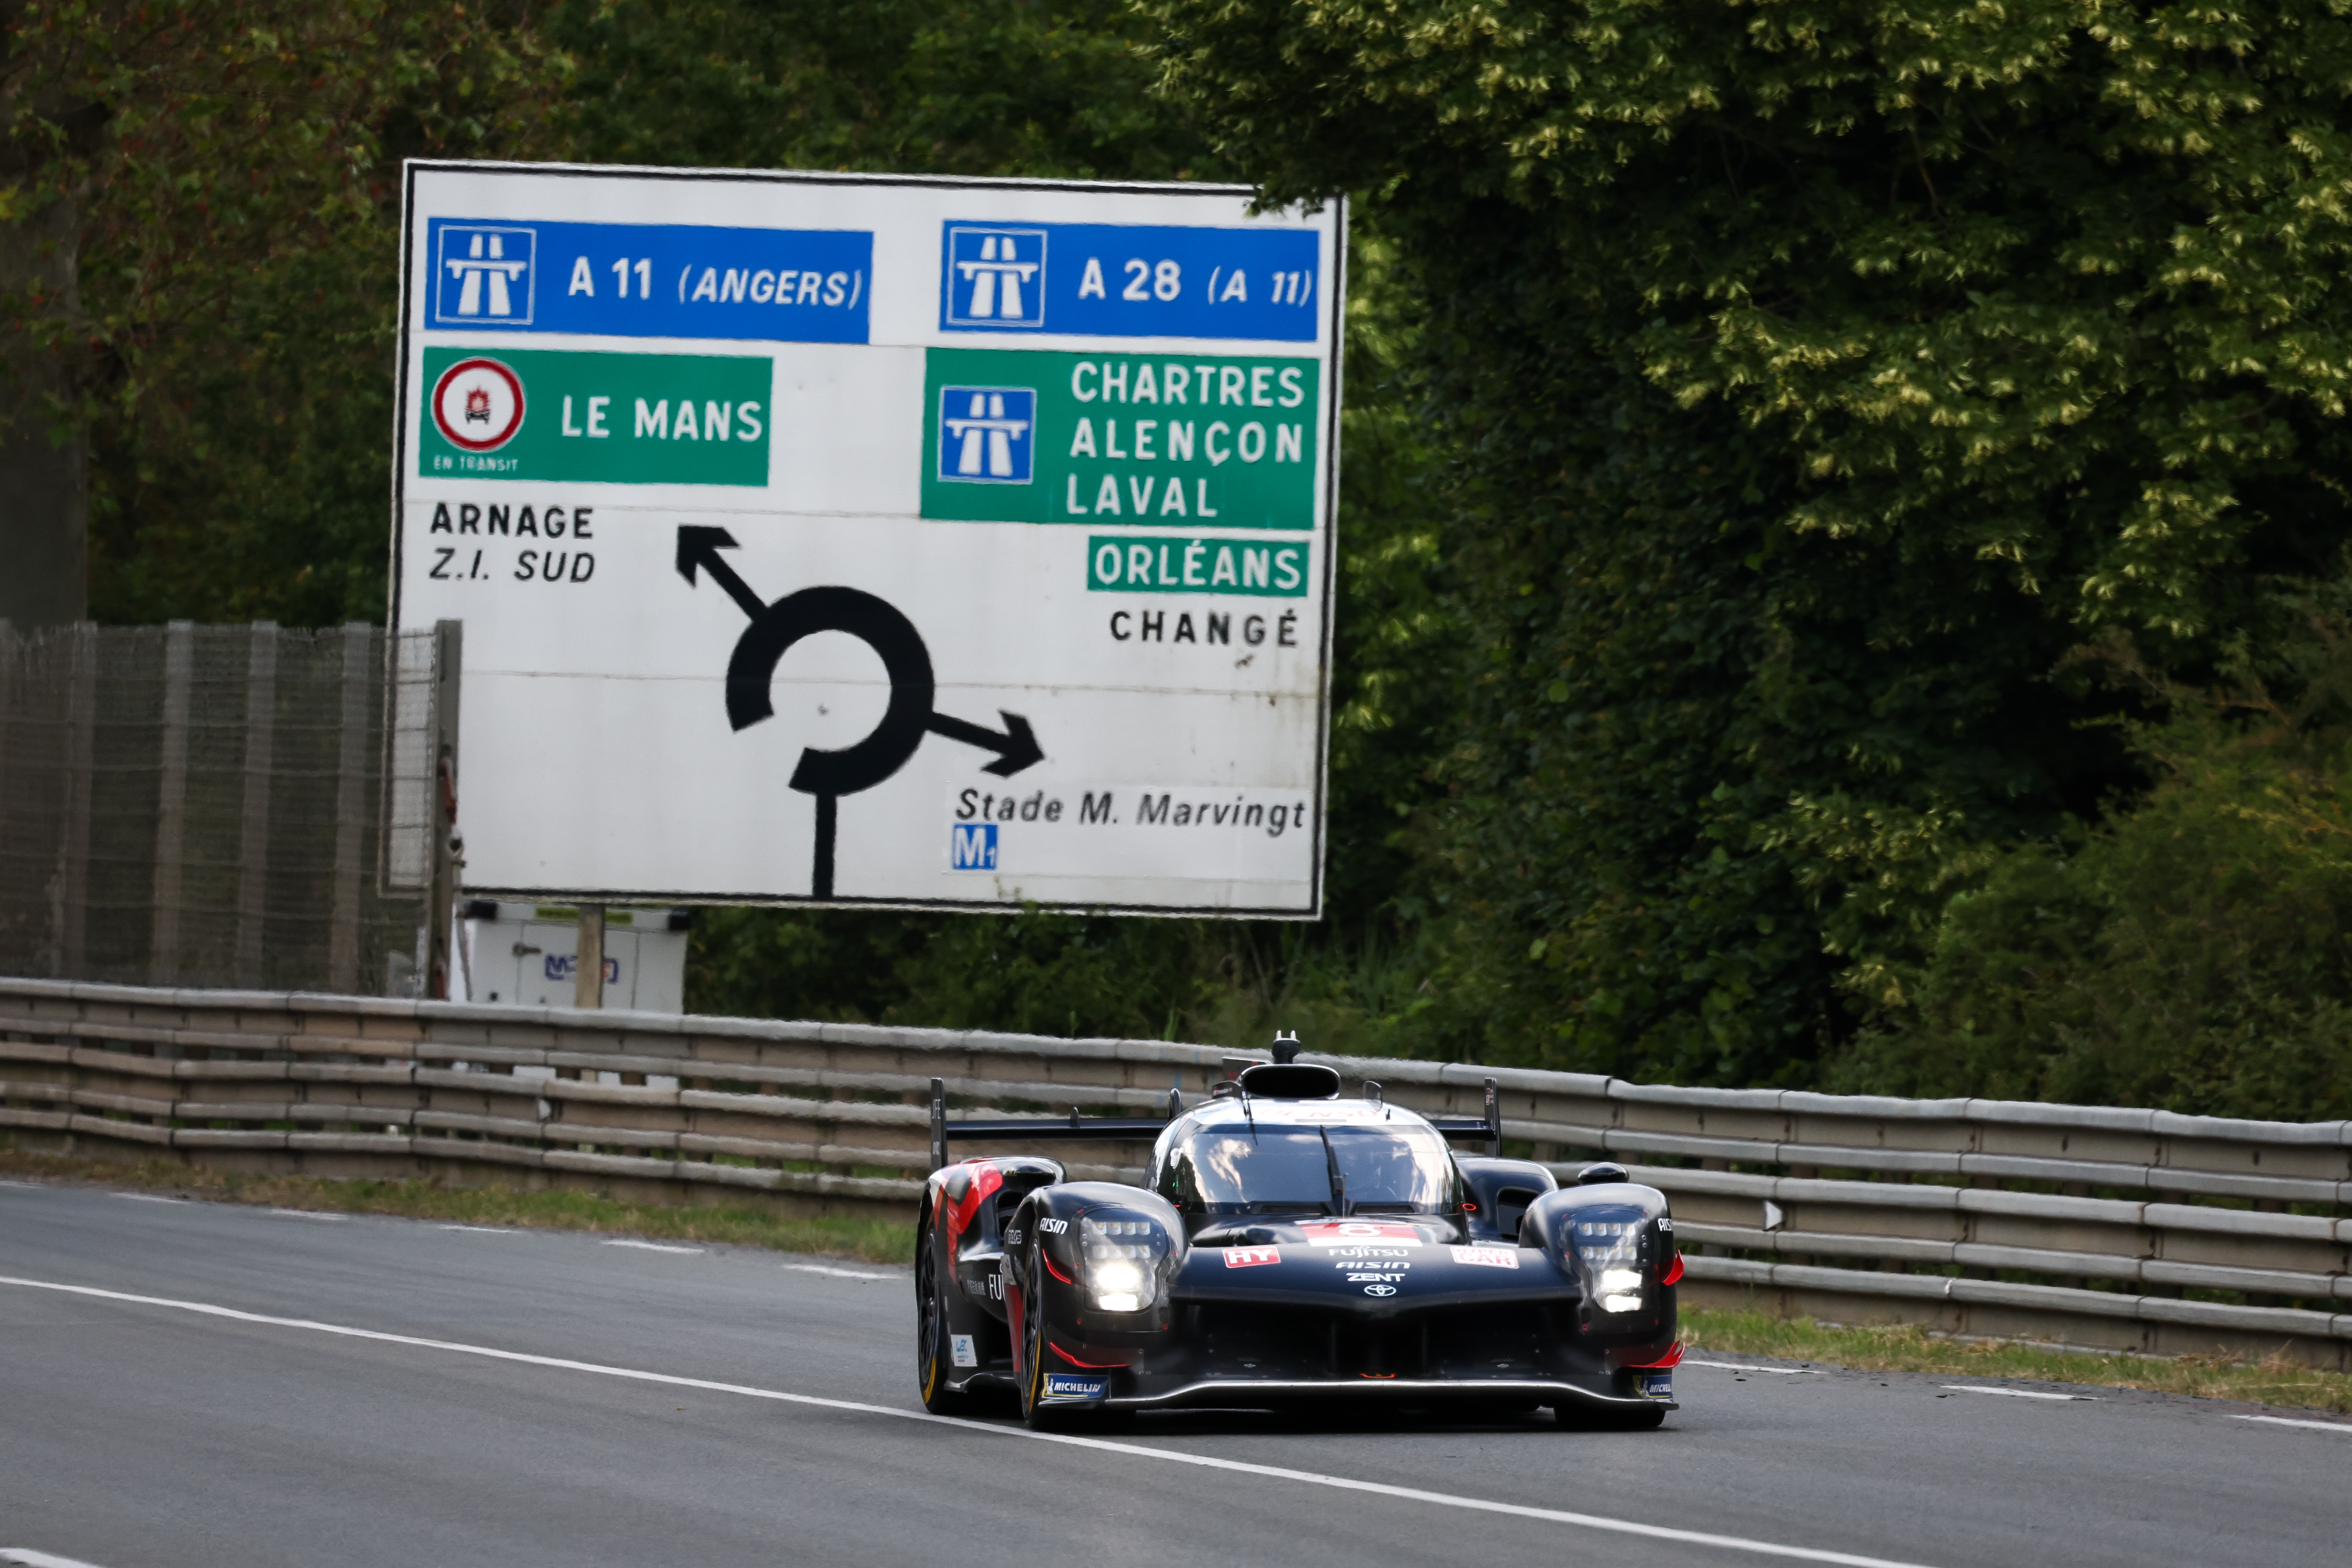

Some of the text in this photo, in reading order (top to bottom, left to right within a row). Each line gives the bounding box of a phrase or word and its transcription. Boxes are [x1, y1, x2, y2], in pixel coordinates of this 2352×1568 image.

[568, 256, 862, 310] A 11 (ANGERS)
[1079, 257, 1311, 307] A 28 (A 11)
[1071, 362, 1303, 408] CHARTRES
[561, 395, 761, 442] LE MANS
[1070, 418, 1302, 467] ALENÇON
[433, 455, 453, 470] EN
[1067, 474, 1218, 516] LAVAL
[430, 502, 593, 539] ARNAGE
[429, 547, 595, 583] Z.I. SUD
[1094, 540, 1300, 590] ORLÉANS
[1110, 608, 1298, 646] CHANGÉ
[956, 788, 1304, 837] Stade M. Marvingt
[1039, 1218, 1068, 1235] AISIN
[1339, 1223, 1381, 1236] 8
[1227, 1249, 1273, 1263] HY
[1328, 1247, 1408, 1258] FUJITSU
[1460, 1253, 1512, 1265] CAR
[1346, 1272, 1405, 1282] ZENT
[1054, 1382, 1101, 1392] MICHELIN
